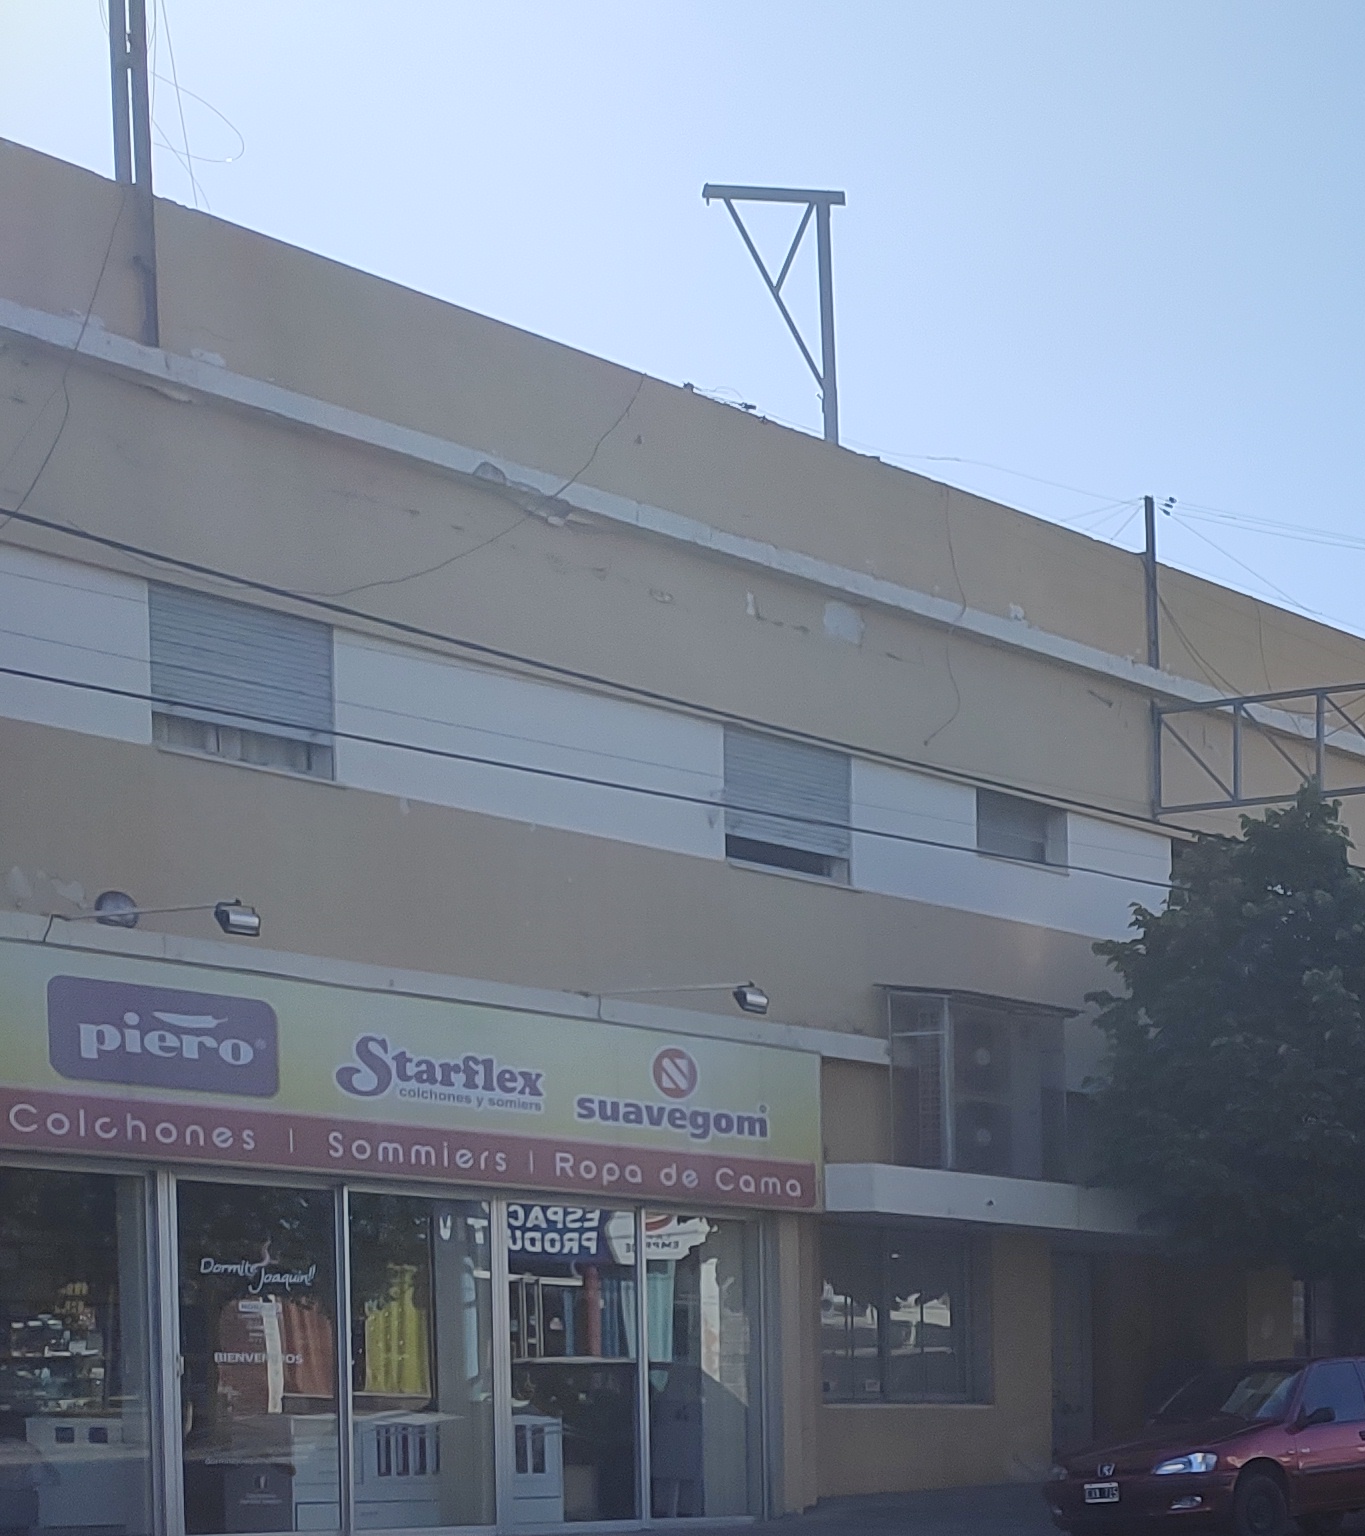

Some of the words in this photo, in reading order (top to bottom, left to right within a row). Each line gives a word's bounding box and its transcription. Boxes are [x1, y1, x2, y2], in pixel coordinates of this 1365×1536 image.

[78, 1012, 254, 1066] piero
[336, 1036, 544, 1097] Starflex
[399, 1086, 472, 1105] colchones
[476, 1096, 484, 1109] y
[488, 1098, 542, 1111] somiers
[575, 1097, 769, 1139] suavegom
[9, 1103, 256, 1150] Colchones
[328, 1131, 507, 1171] Sommiers
[555, 1152, 642, 1185] Ropa
[660, 1163, 699, 1188] de
[715, 1167, 801, 1197] Cama
